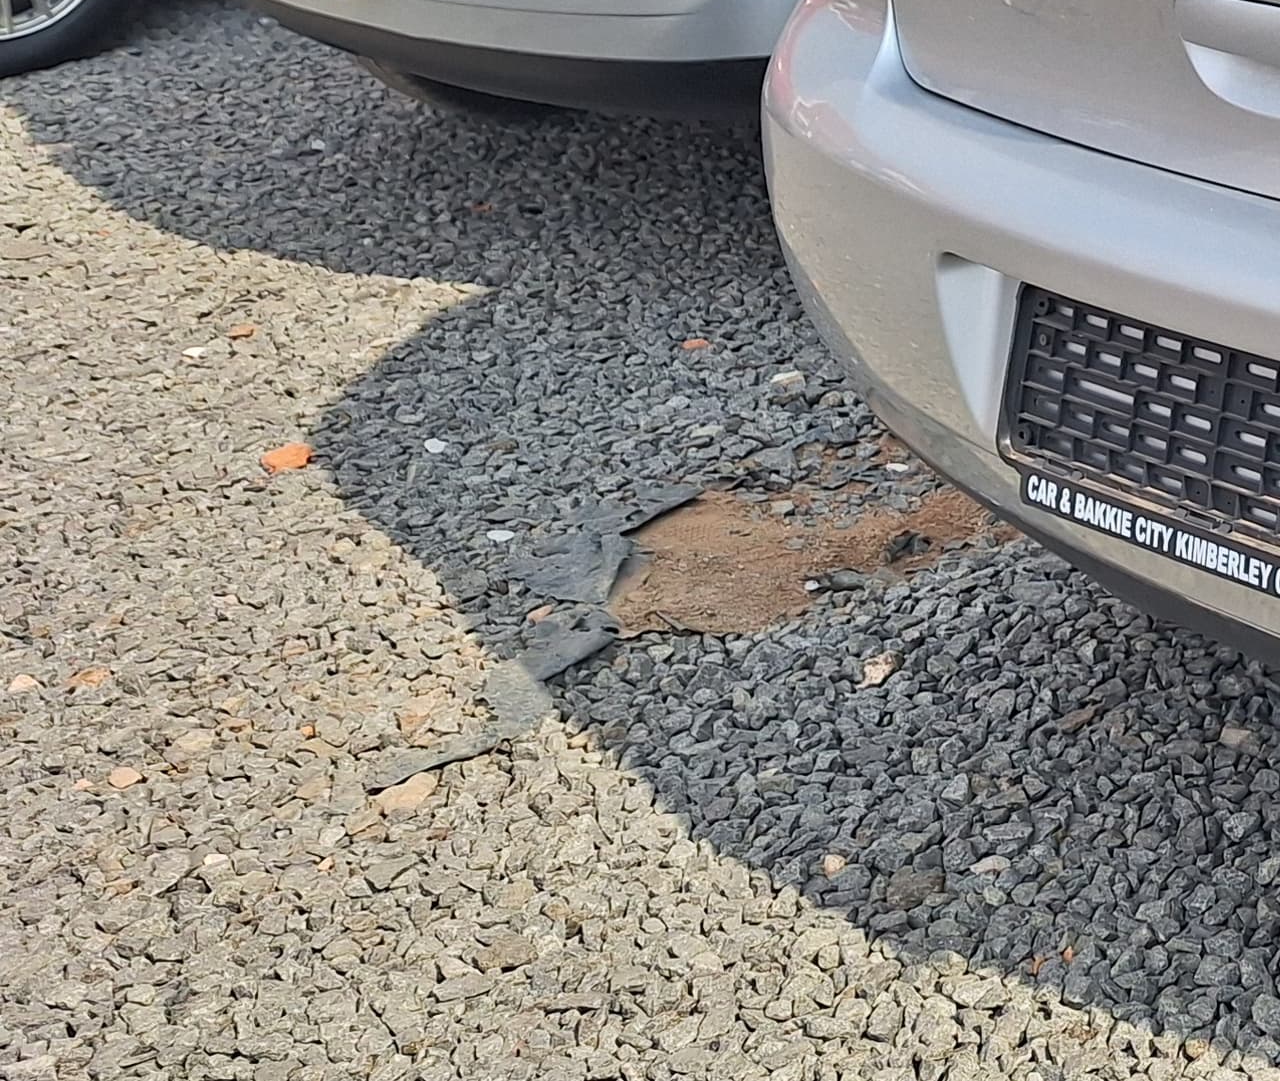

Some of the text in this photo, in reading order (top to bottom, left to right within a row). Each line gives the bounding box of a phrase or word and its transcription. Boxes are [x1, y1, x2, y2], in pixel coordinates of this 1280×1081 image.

[1027, 475, 1058, 509] CAR
[1059, 488, 1071, 515] &
[1074, 493, 1133, 538] BAKKIE
[1135, 517, 1174, 552] CITY
[1175, 530, 1273, 589] KIMBERLEY
